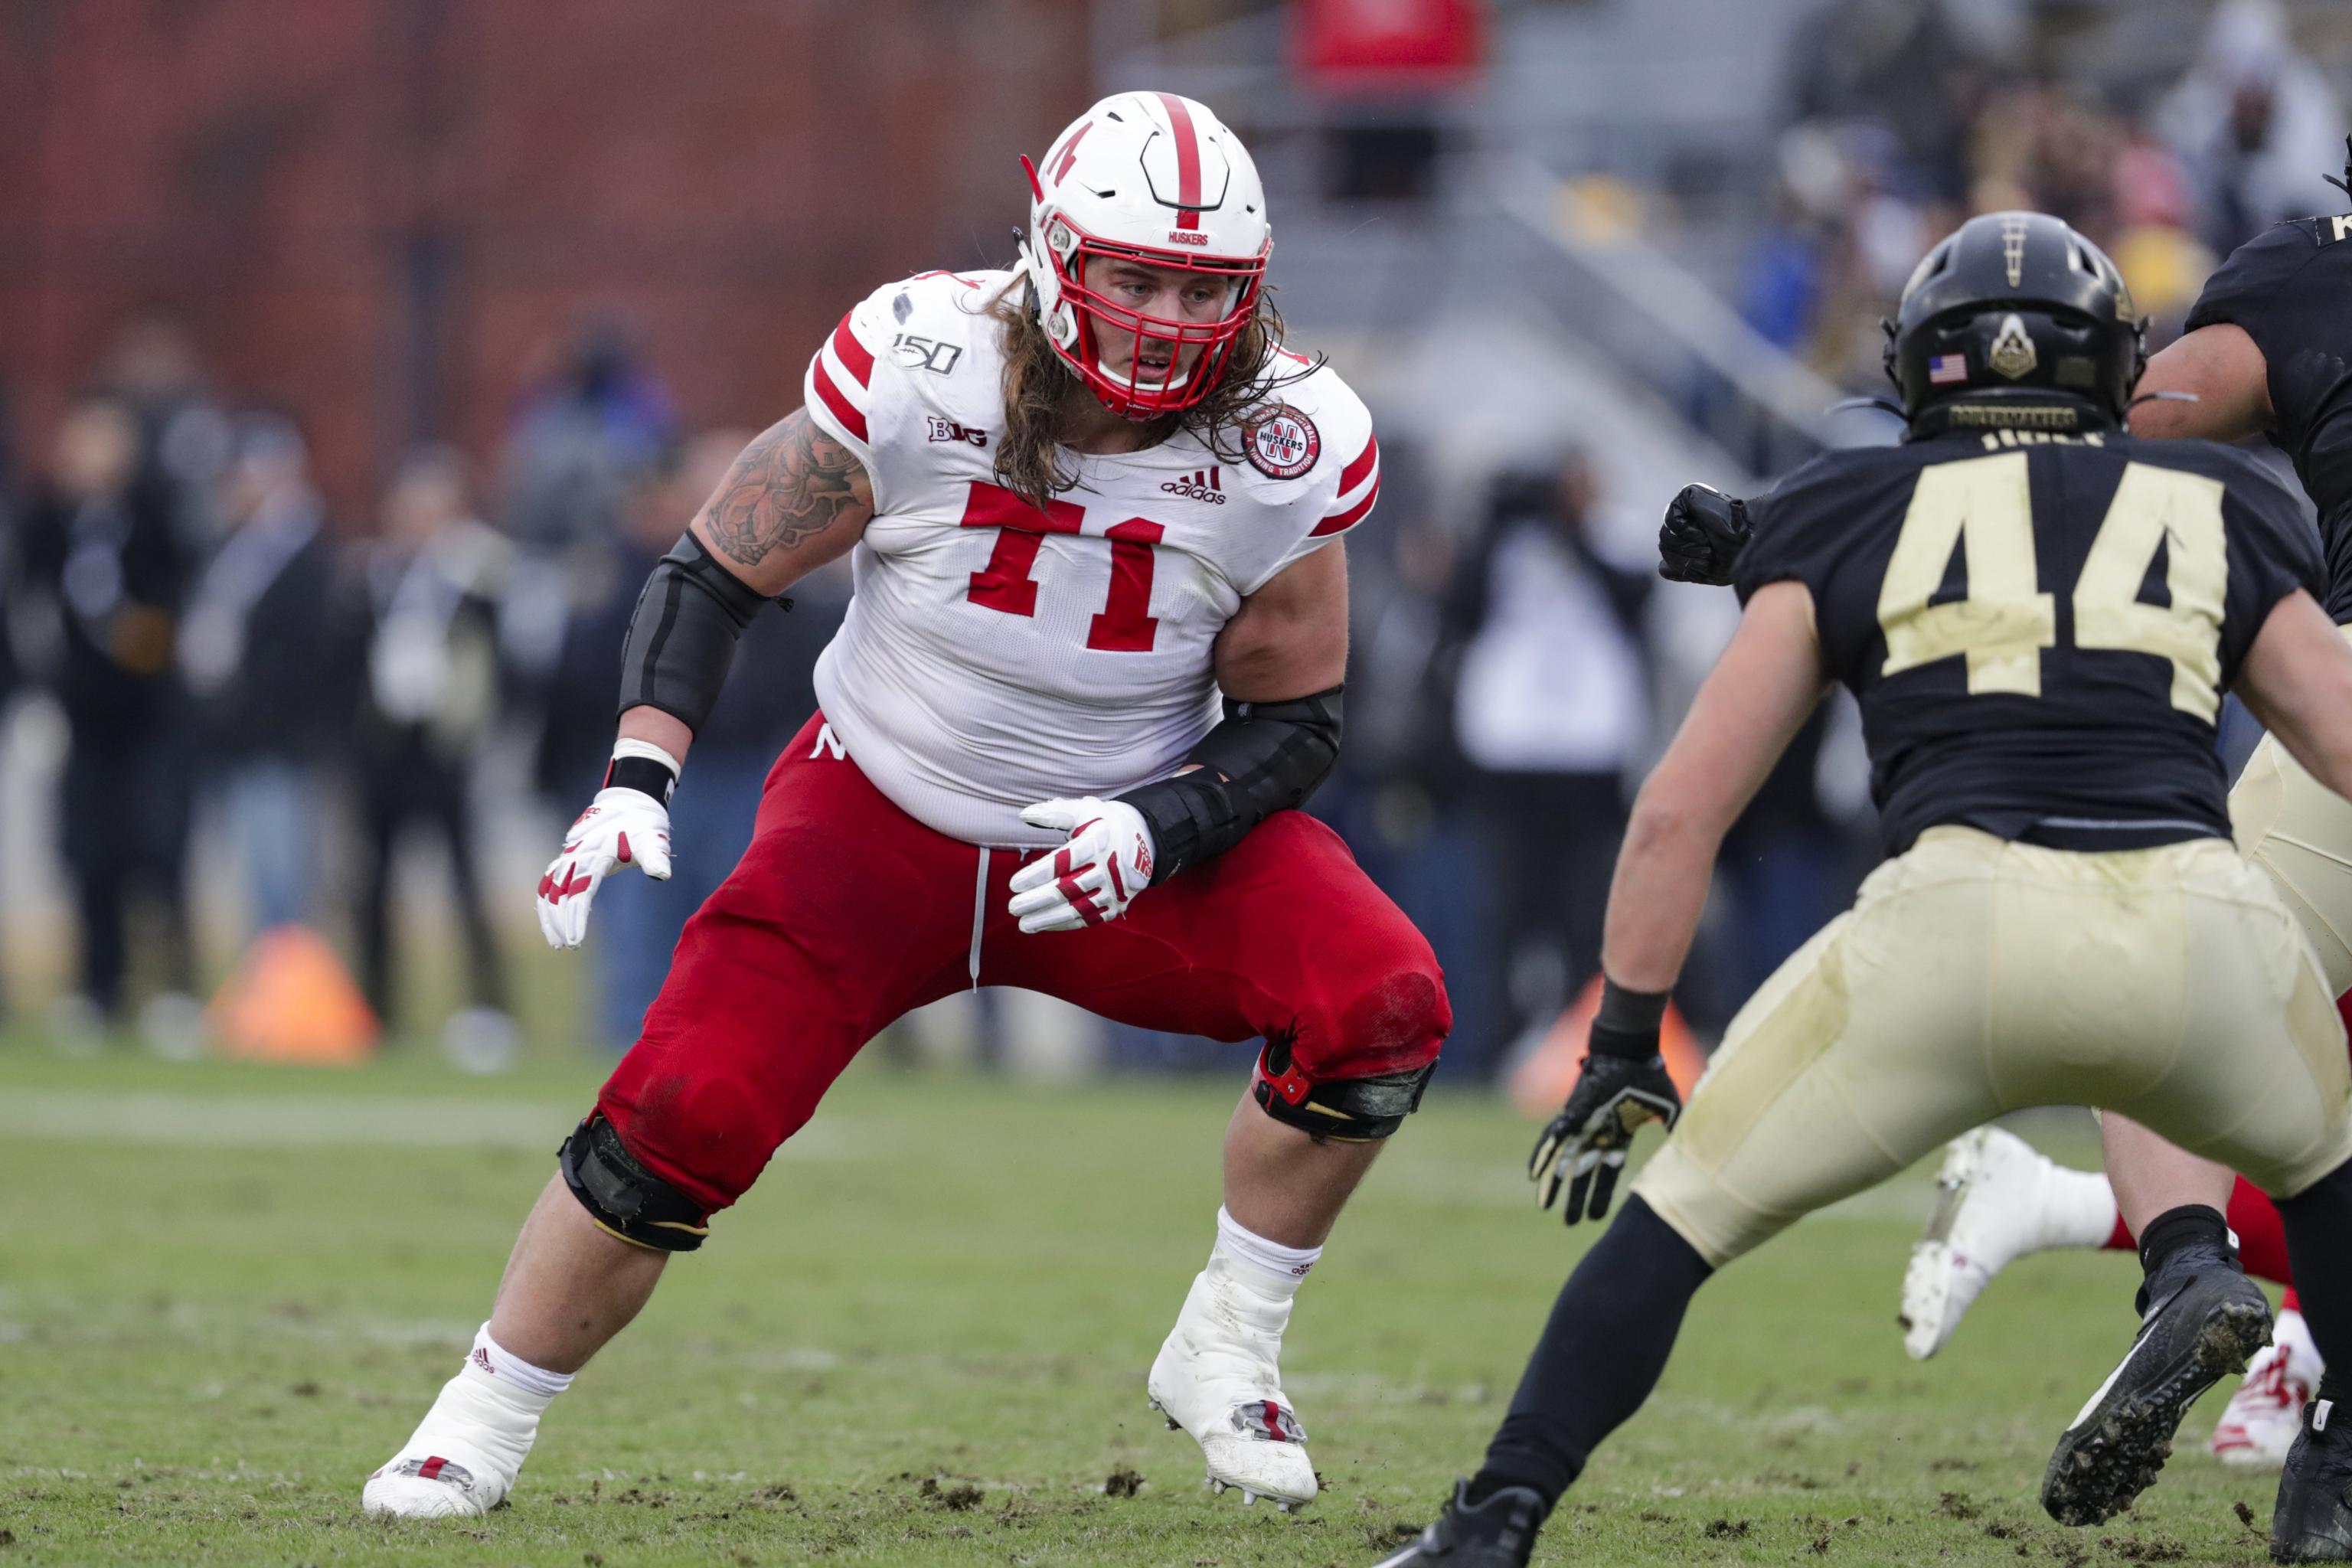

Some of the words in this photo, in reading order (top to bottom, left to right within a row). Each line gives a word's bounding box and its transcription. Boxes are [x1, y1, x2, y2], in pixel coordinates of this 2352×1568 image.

[1168, 231, 1208, 246] HUSKERS
[893, 333, 962, 374] 150
[1260, 432, 1303, 451] HUSKERS
[1279, 454, 1314, 475] TRADITION
[1161, 482, 1227, 505] adidas
[960, 484, 1165, 652] 71
[1877, 450, 2229, 727] 44
